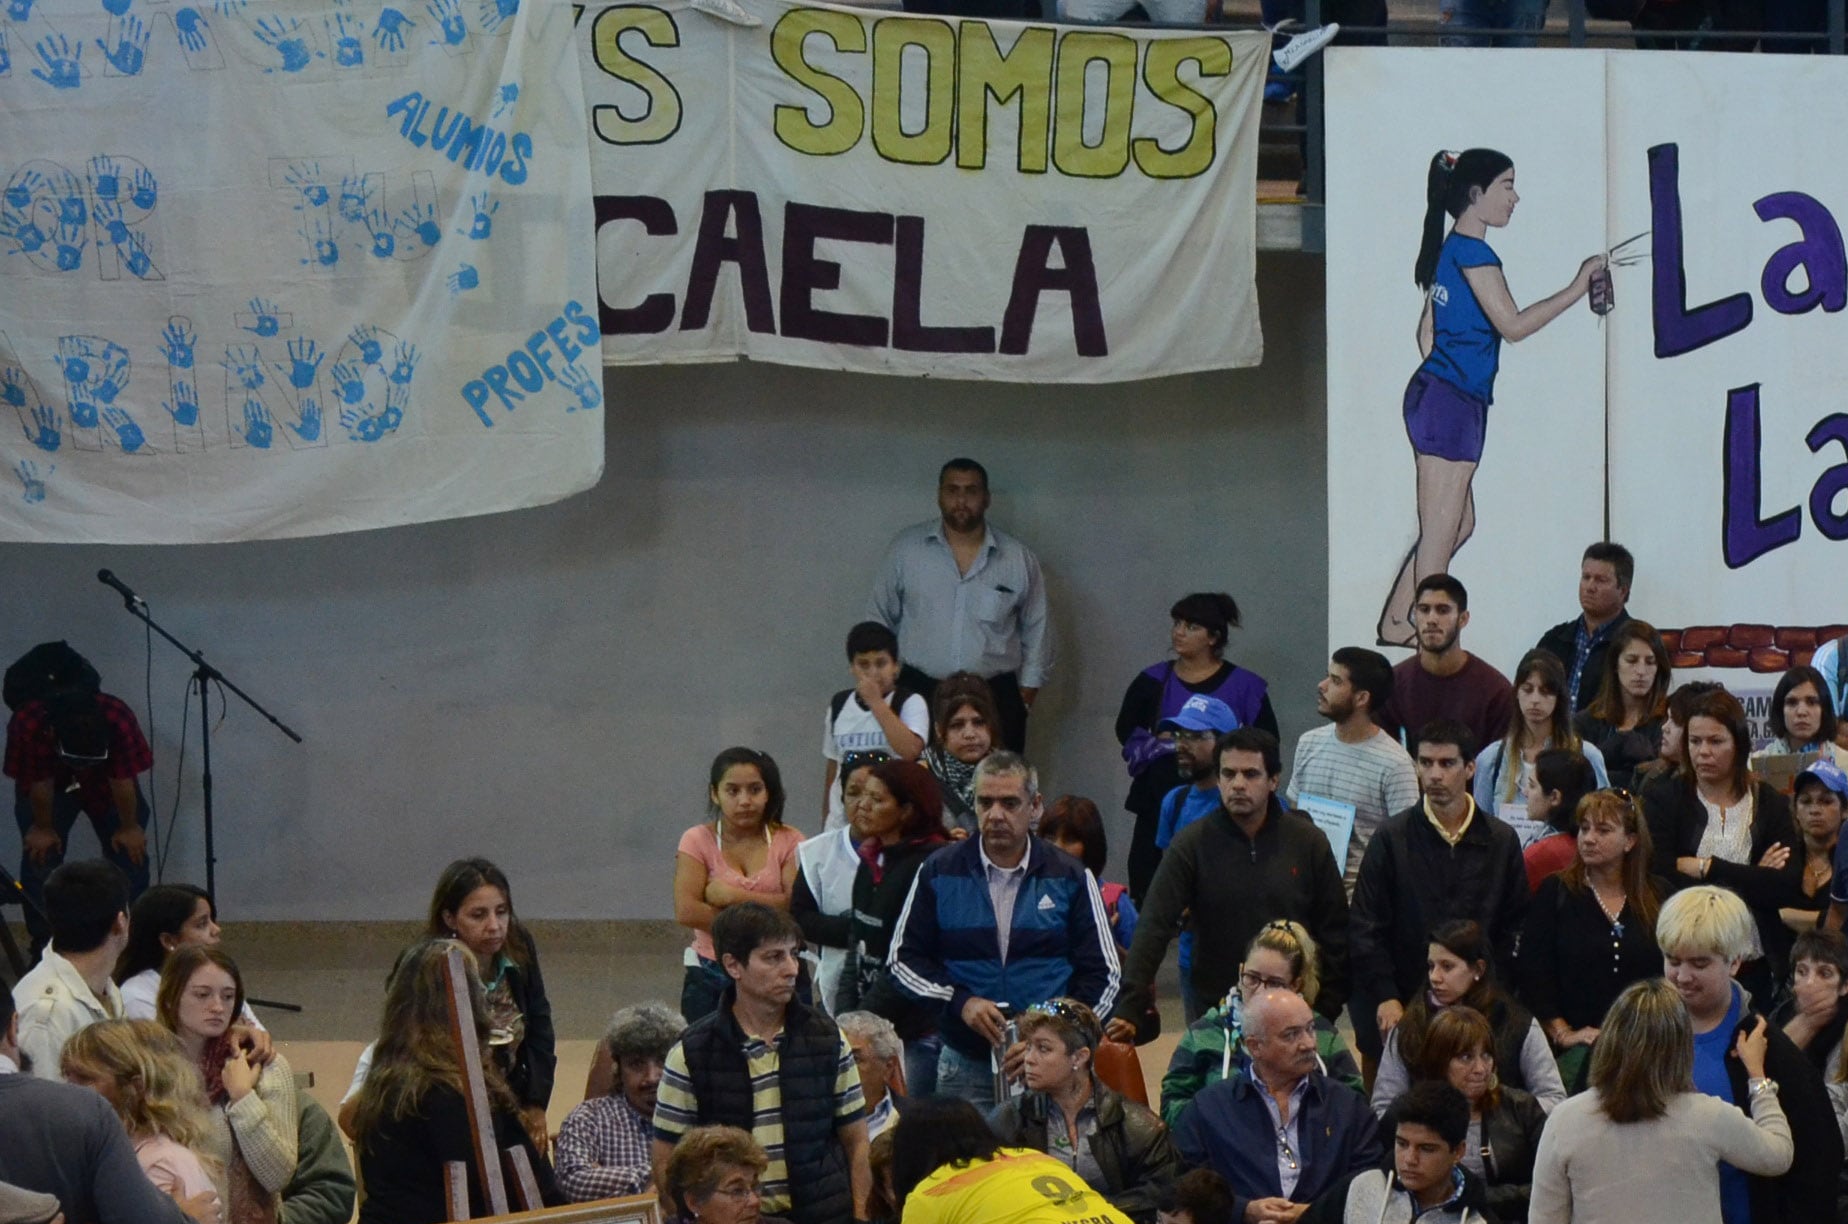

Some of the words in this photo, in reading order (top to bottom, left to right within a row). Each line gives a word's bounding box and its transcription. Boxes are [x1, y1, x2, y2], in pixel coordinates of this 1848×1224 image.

[769, 7, 1234, 180] SOMOS
[592, 189, 1109, 358] CAELA
[461, 300, 601, 428] PROFES
